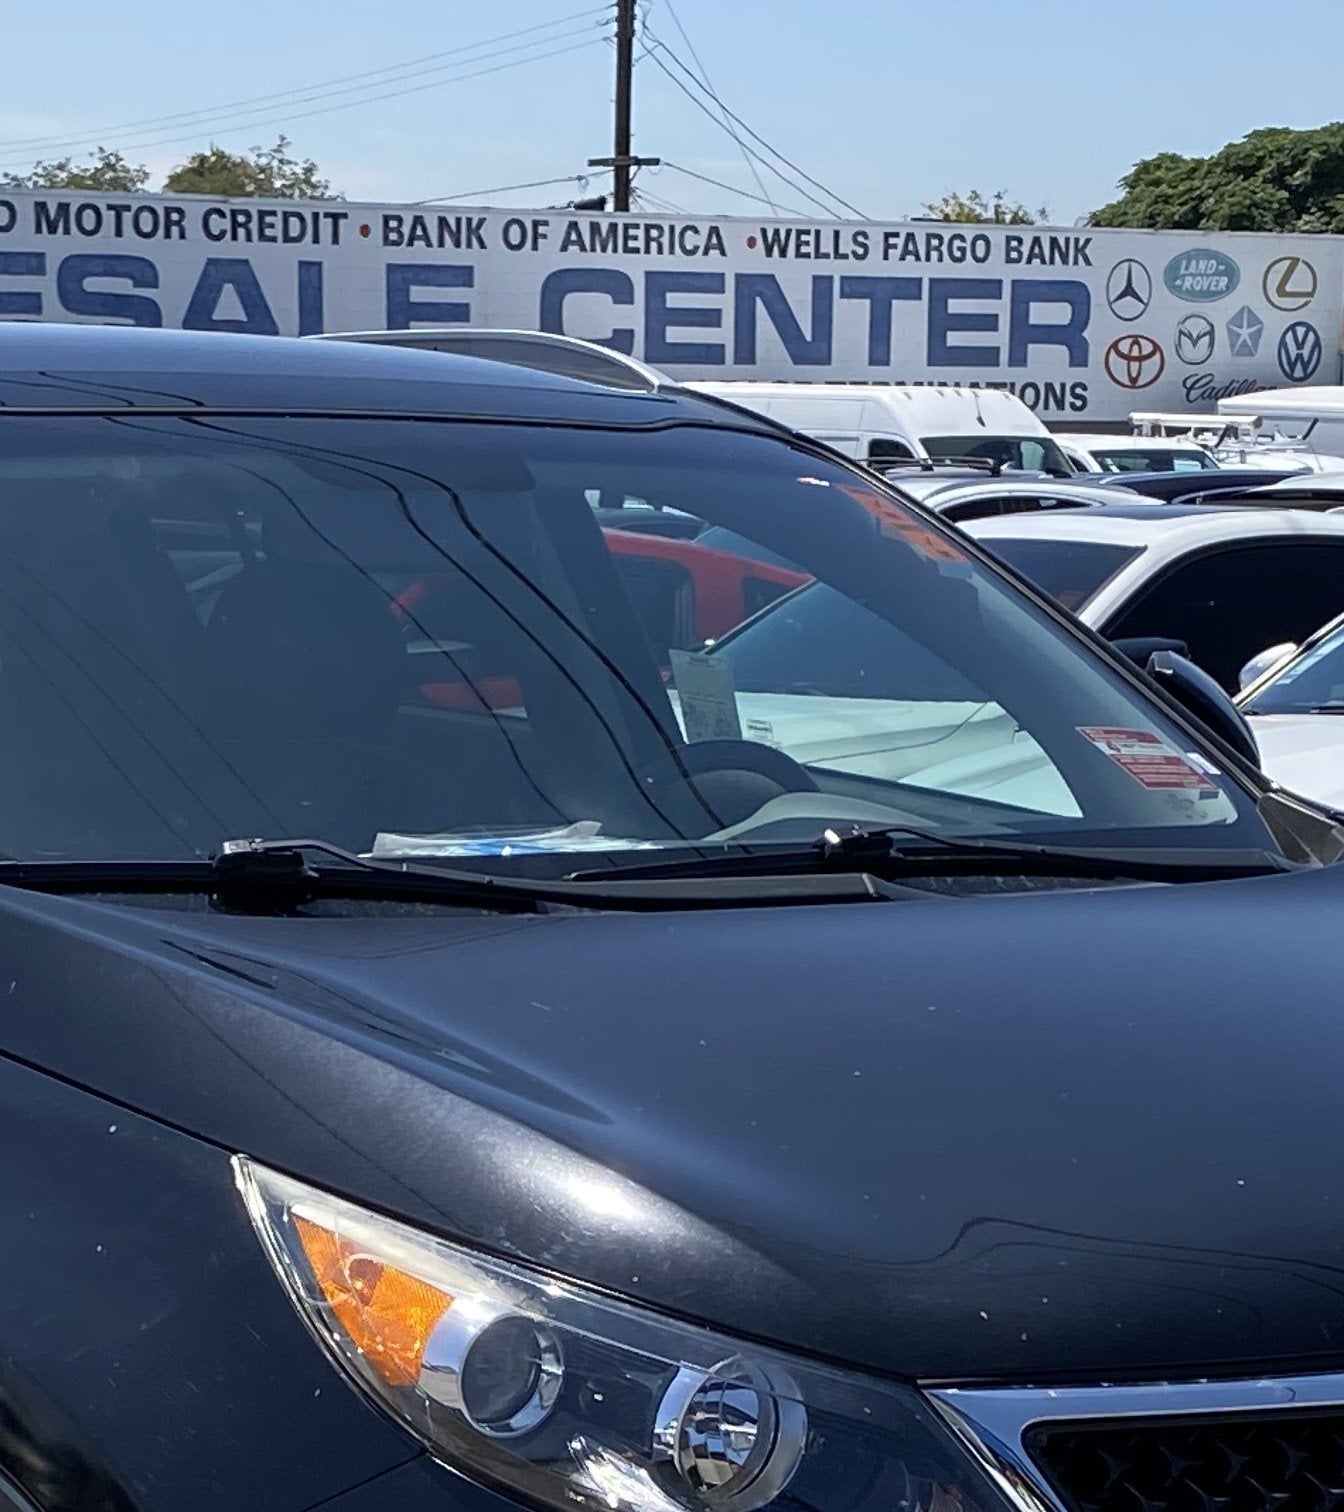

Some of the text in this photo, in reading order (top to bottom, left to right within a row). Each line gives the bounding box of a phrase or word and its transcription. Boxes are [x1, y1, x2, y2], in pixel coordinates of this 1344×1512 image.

[33, 201, 187, 240] MOTOR
[201, 207, 349, 246] CREDIT
[381, 214, 487, 250] BANK
[502, 217, 549, 252] OF
[559, 220, 727, 257] AMERICA
[760, 227, 870, 261] WELLS
[882, 231, 992, 264] FARGO
[1003, 235, 1093, 267] BANK
[539, 267, 1092, 368] CENTER
[1183, 373, 1277, 403] Cadill
